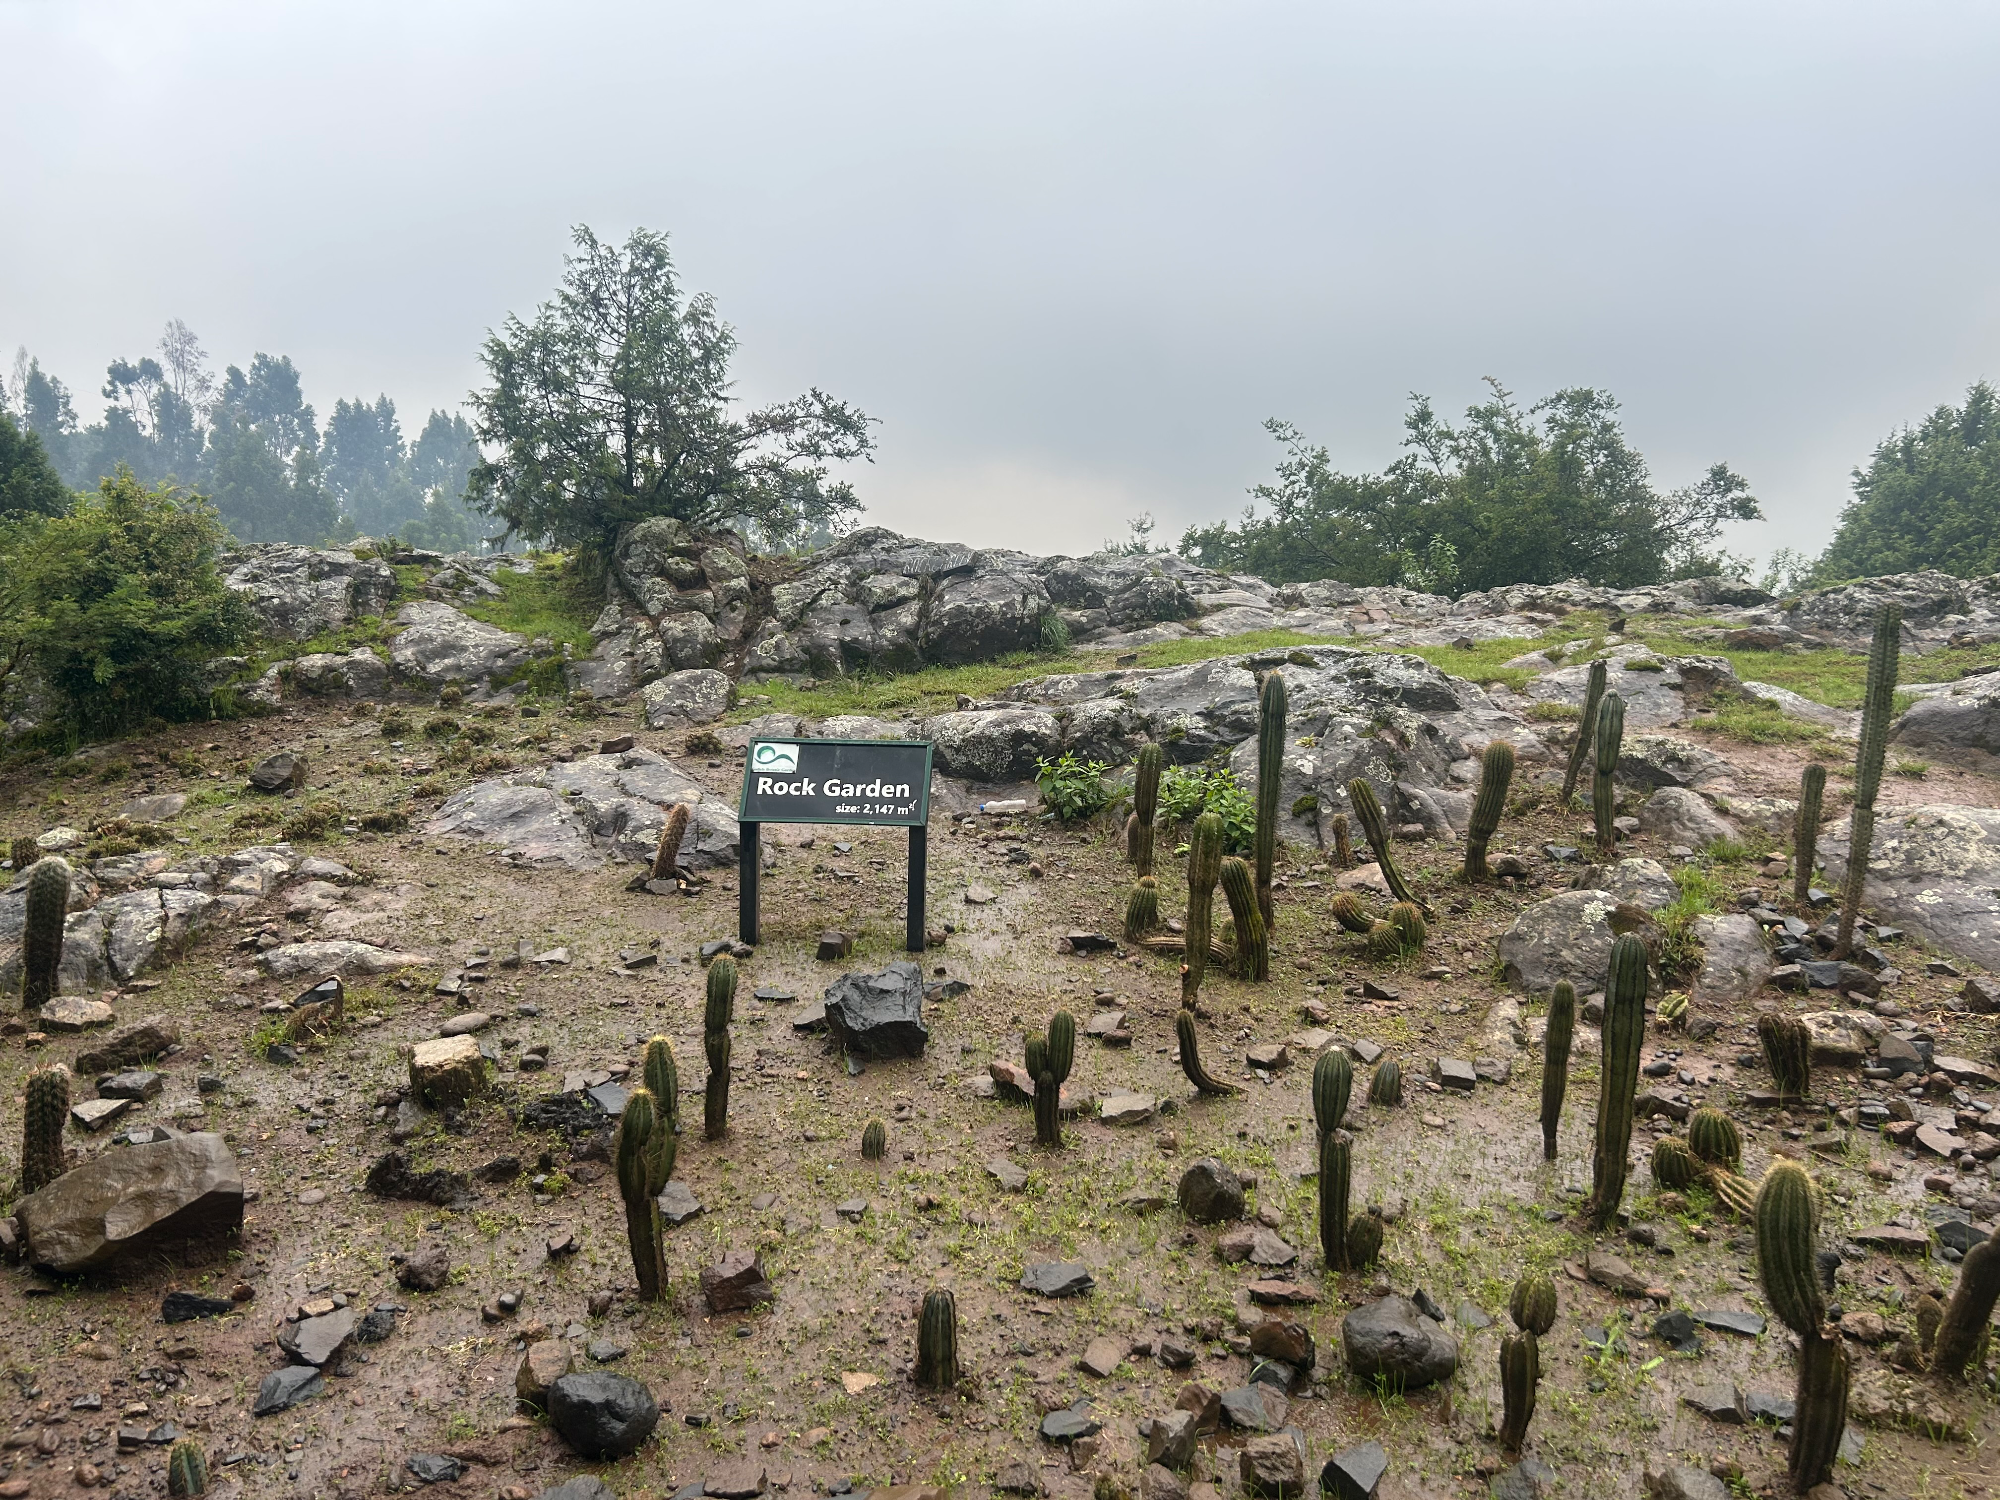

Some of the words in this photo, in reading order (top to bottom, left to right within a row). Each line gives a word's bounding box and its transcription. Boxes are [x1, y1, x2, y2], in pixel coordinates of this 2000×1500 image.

[757, 777, 816, 796] Rock
[823, 779, 910, 798] Garden
[835, 803, 860, 813] size:
[863, 803, 894, 815] 2,147
